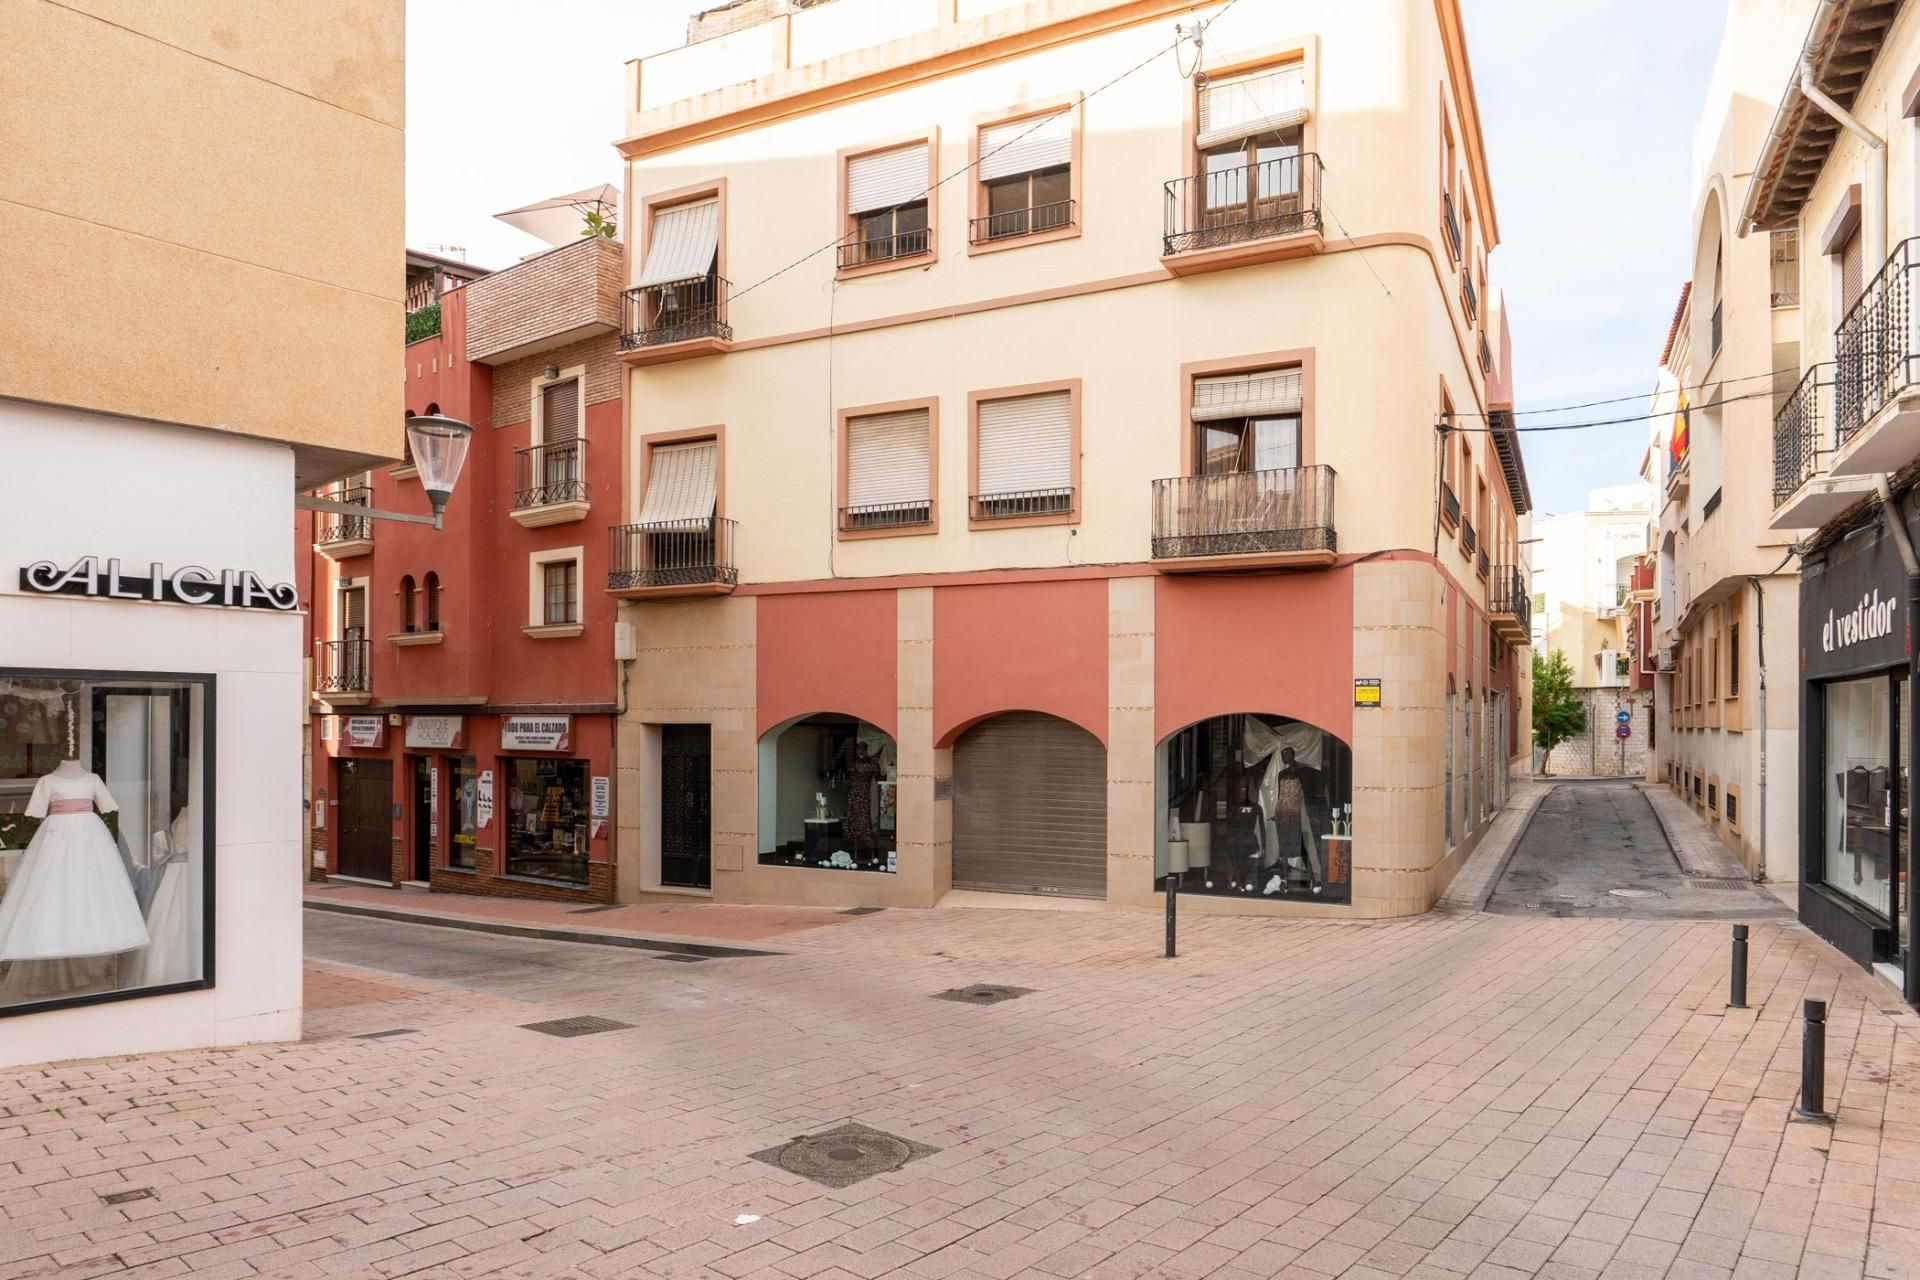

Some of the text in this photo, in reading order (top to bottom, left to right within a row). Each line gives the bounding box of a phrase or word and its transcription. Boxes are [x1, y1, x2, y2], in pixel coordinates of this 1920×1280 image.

[27, 555, 299, 610] ALICIA
[1822, 588, 1897, 652] el vestidor
[417, 718, 449, 730] BOUTIQUE
[519, 722, 534, 733] PARA
[534, 722, 540, 733] EL
[541, 722, 567, 733] CALZADO
[422, 729, 449, 741] CALZADO
